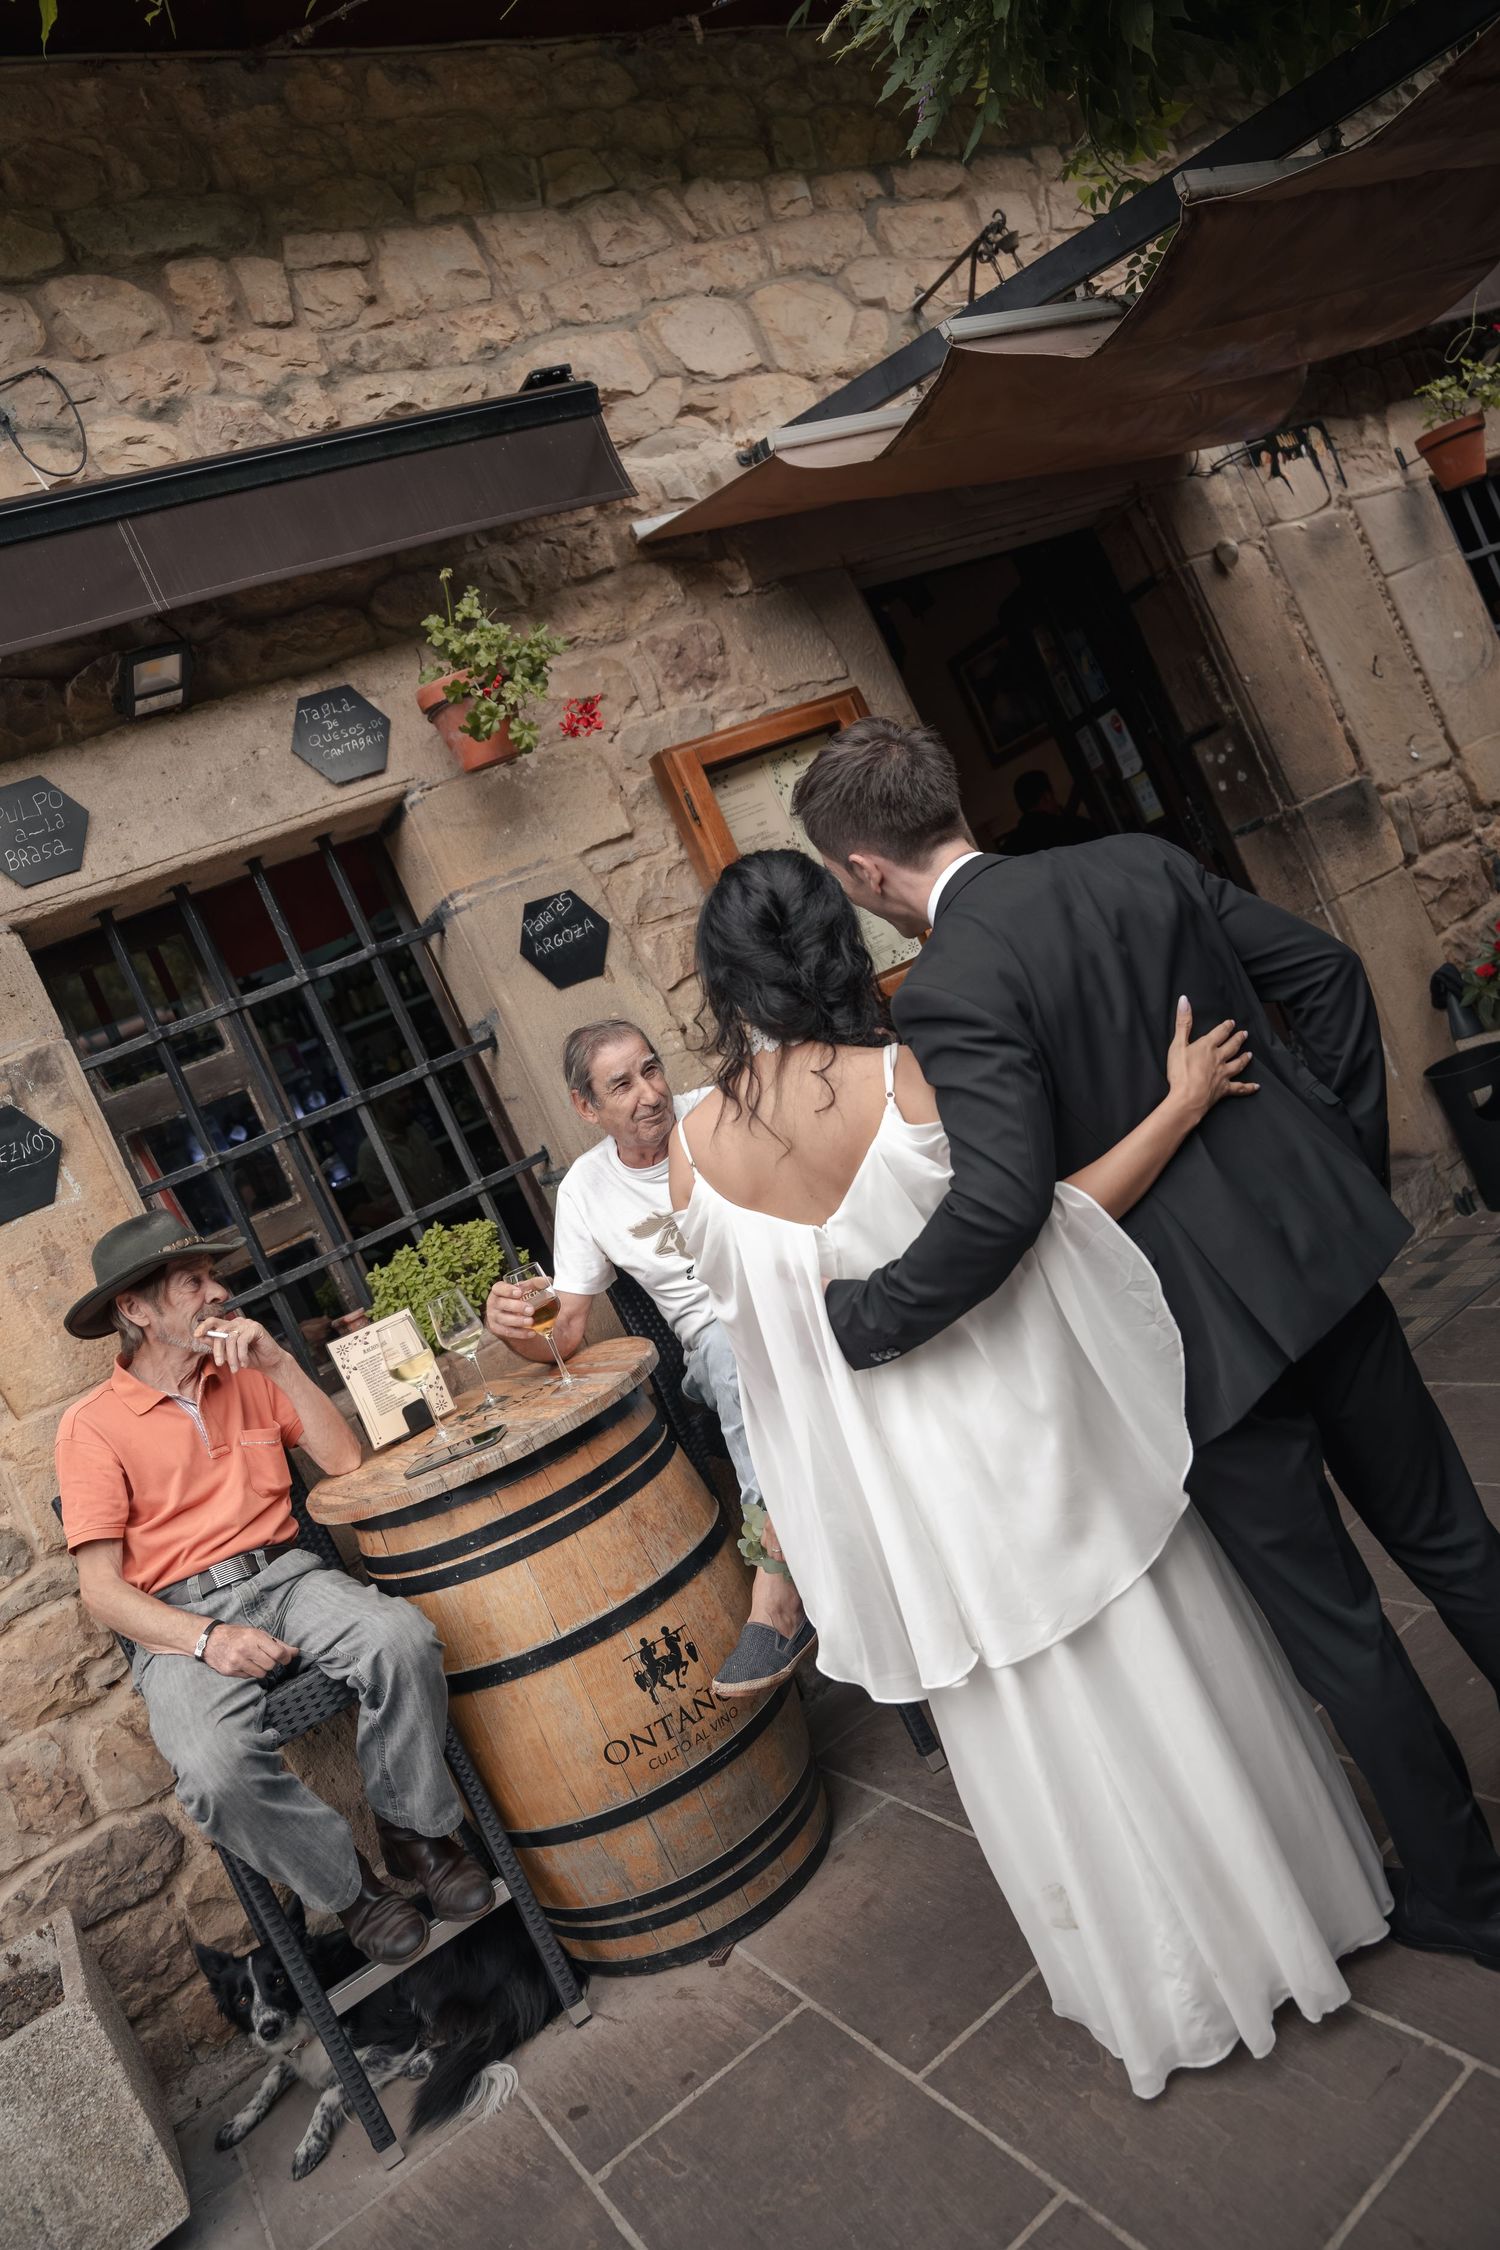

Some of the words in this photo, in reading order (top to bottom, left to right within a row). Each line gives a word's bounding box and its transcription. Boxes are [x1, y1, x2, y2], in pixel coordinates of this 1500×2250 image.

[322, 718, 340, 730] DE
[322, 731, 385, 760] CANTABRIA
[534, 917, 596, 957] ARGOZA
[603, 1687, 732, 1765] ONTAÑ
[648, 1739, 693, 1770] CULTO
[695, 1728, 711, 1746] AL
[709, 1706, 738, 1732] VINO
